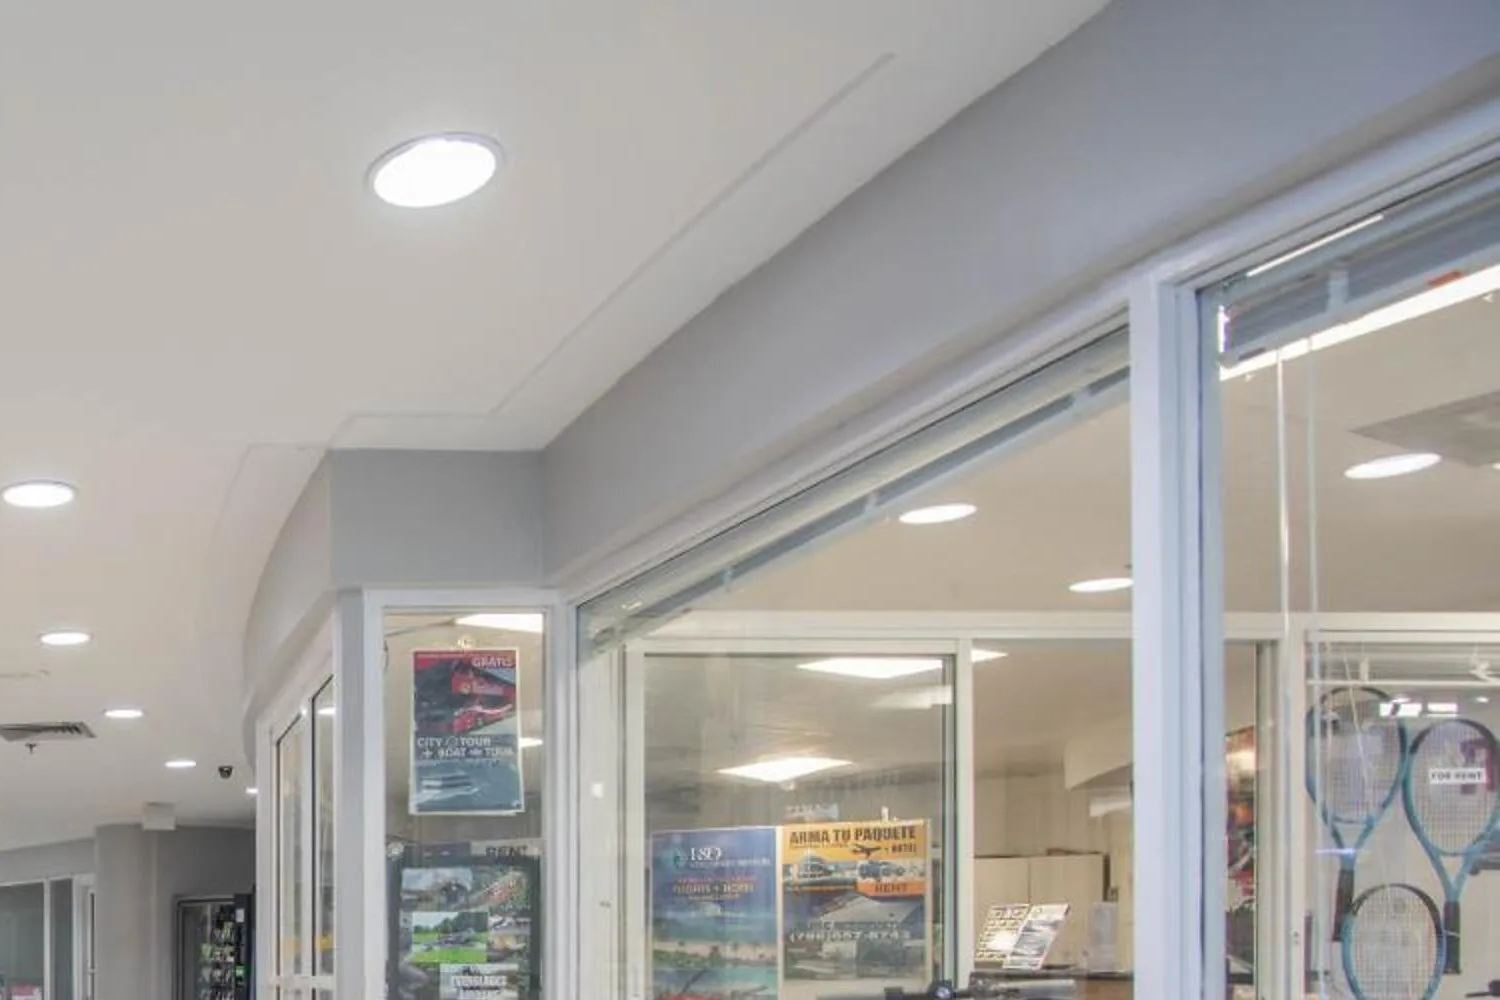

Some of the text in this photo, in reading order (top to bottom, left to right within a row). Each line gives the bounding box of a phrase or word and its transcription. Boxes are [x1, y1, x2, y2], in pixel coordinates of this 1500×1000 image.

[417, 736, 492, 748] CITY TOUR
[789, 825, 917, 845] ARMA TU PAQUETE
